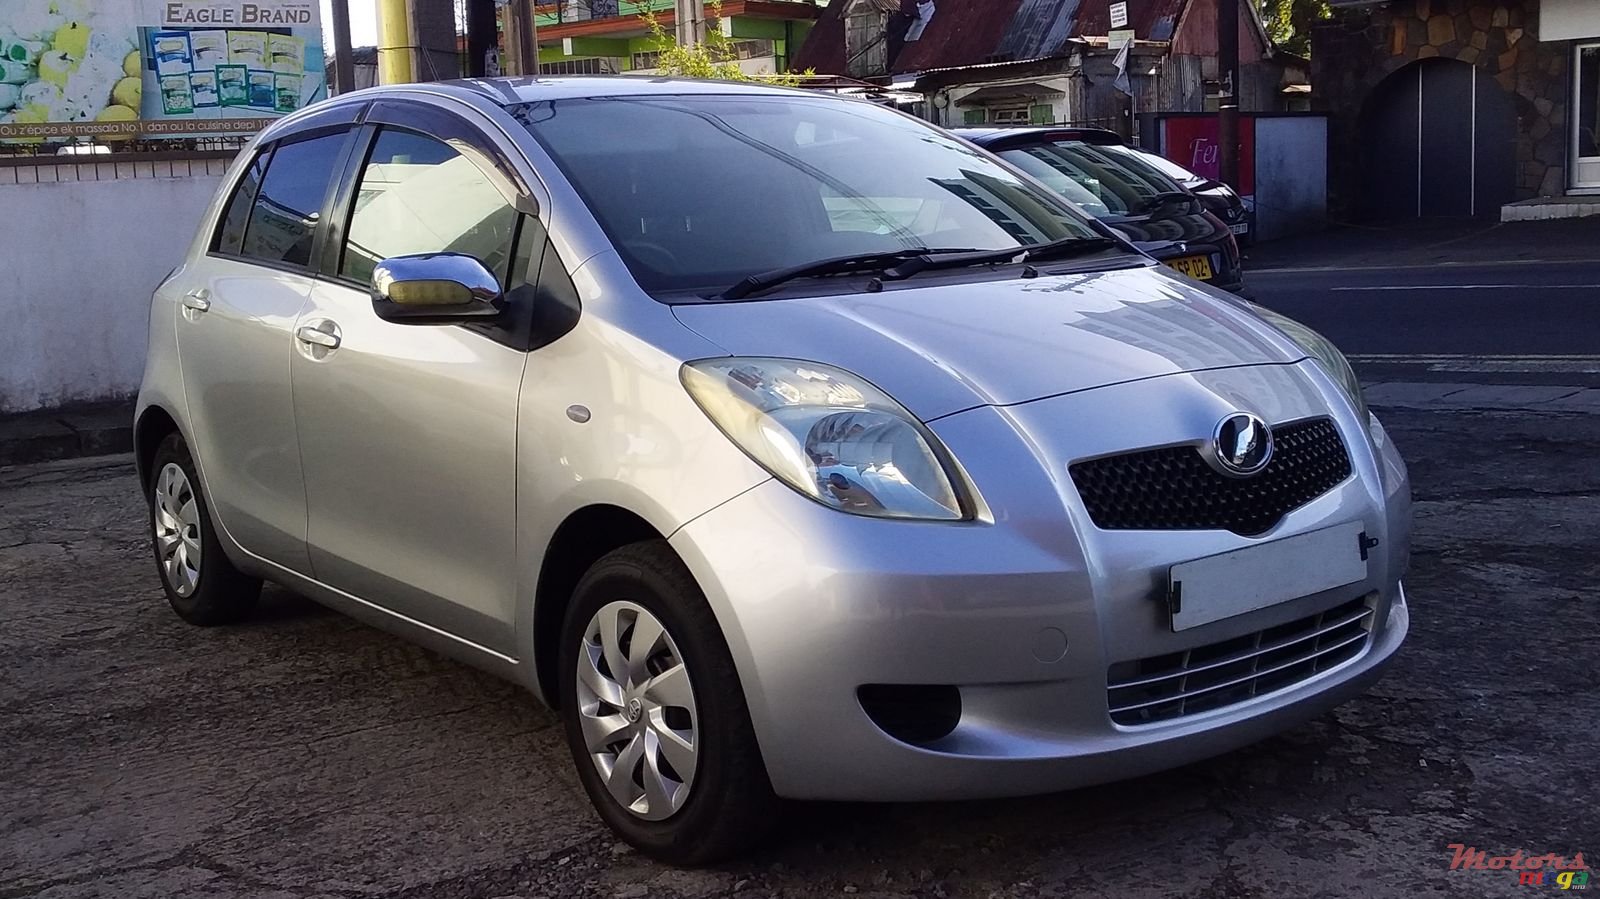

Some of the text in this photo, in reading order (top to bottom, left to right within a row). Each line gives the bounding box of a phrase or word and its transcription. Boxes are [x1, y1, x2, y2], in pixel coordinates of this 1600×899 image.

[166, 3, 311, 23] EAGLE BRAND
[1, 125, 17, 136] Ou
[60, 124, 74, 134] ek
[75, 124, 119, 134] massala
[147, 122, 168, 132] dan
[170, 122, 183, 131] ou
[185, 121, 195, 130] la
[197, 120, 231, 130] cuisine
[233, 119, 256, 131] depi
